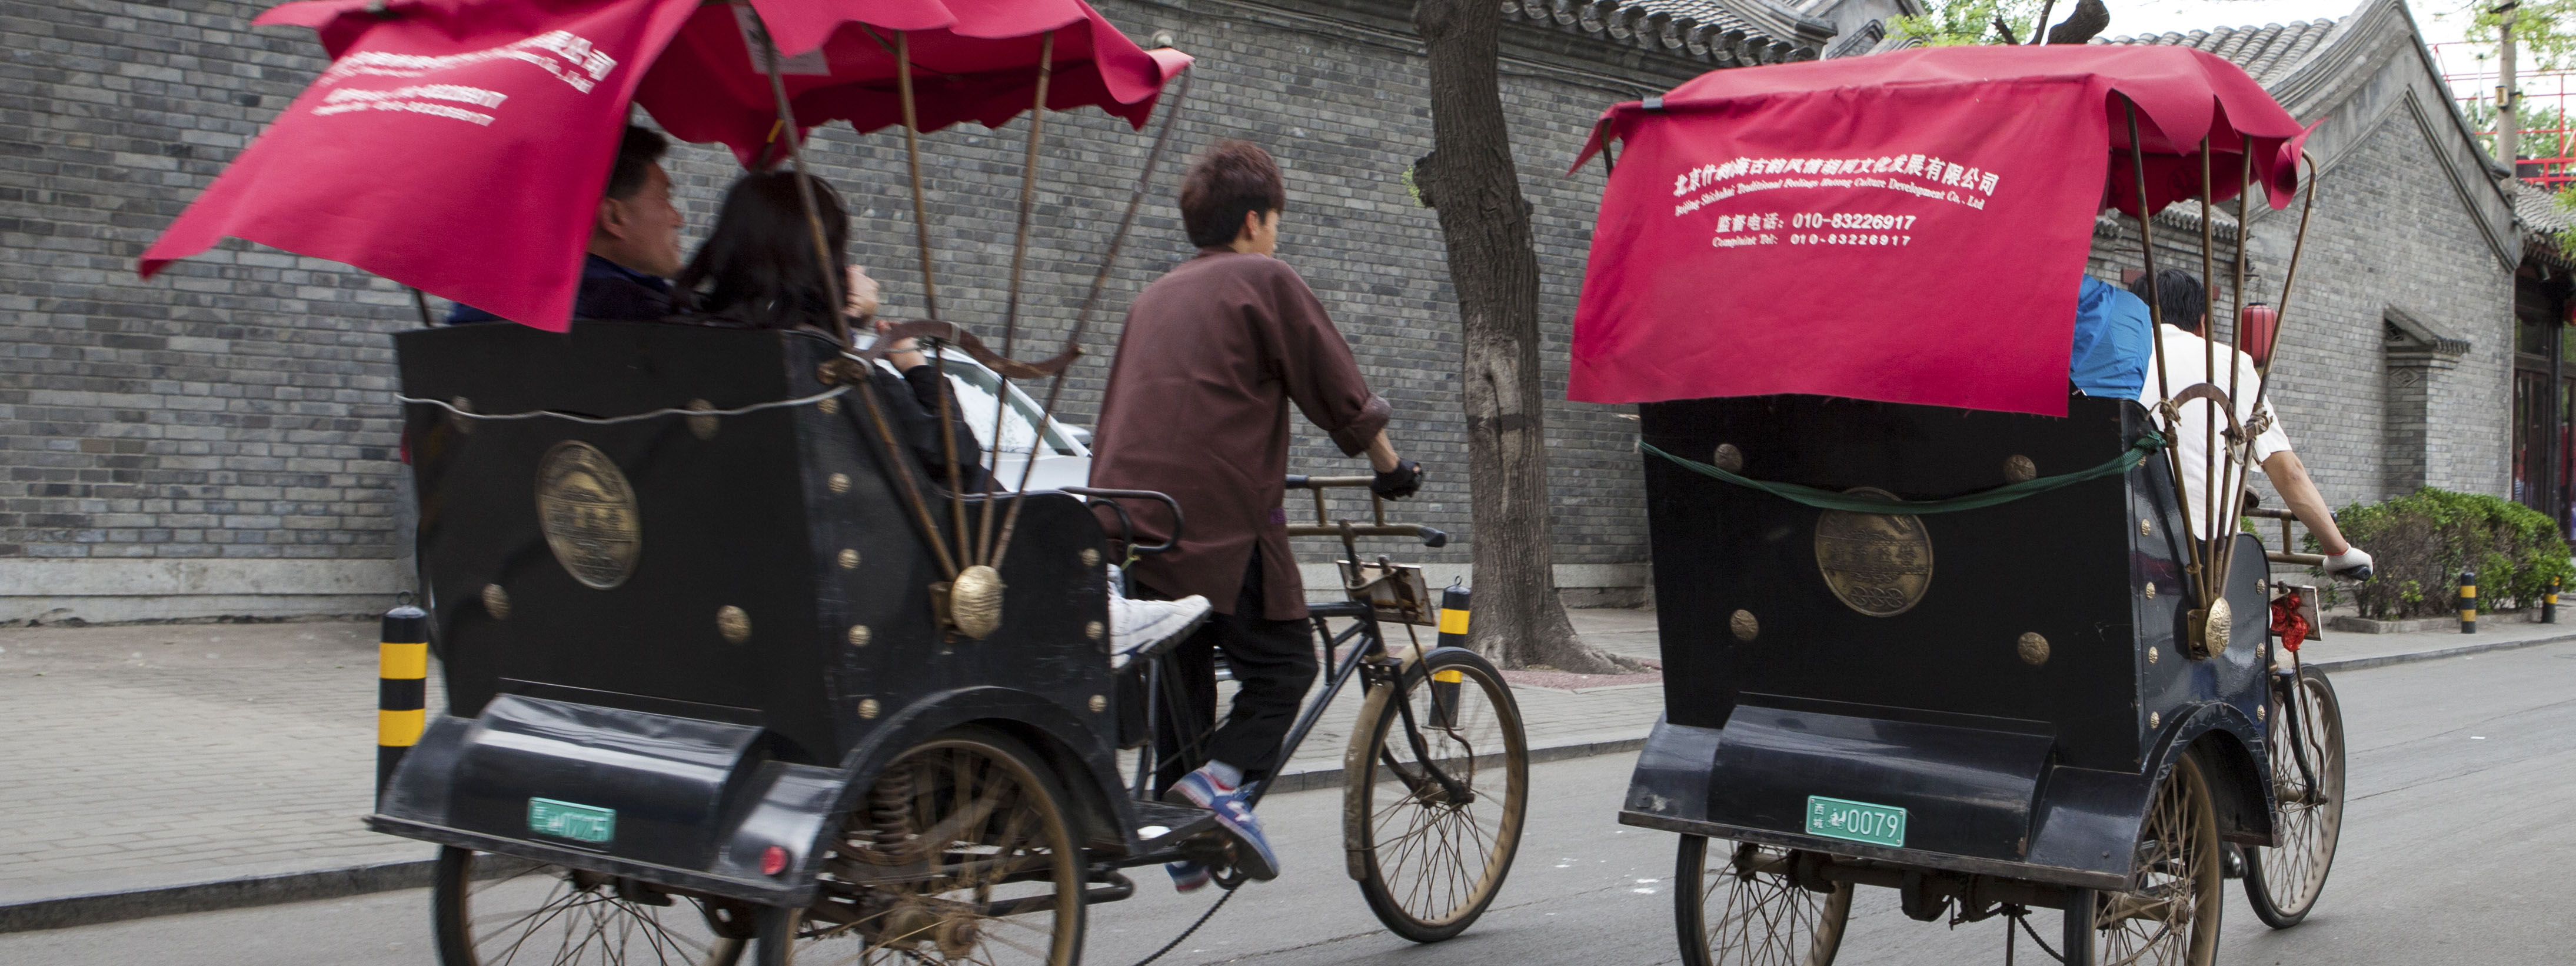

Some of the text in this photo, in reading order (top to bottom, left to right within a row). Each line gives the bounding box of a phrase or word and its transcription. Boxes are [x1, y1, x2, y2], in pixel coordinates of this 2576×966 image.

[1854, 178, 1886, 188] Culture
[1888, 178, 1945, 199] Development
[1792, 212, 1916, 230] 010-83226917
[1712, 235, 1757, 248] Complaint
[1790, 234, 1911, 246] 010-83226917
[1847, 809, 1899, 838] 0079
